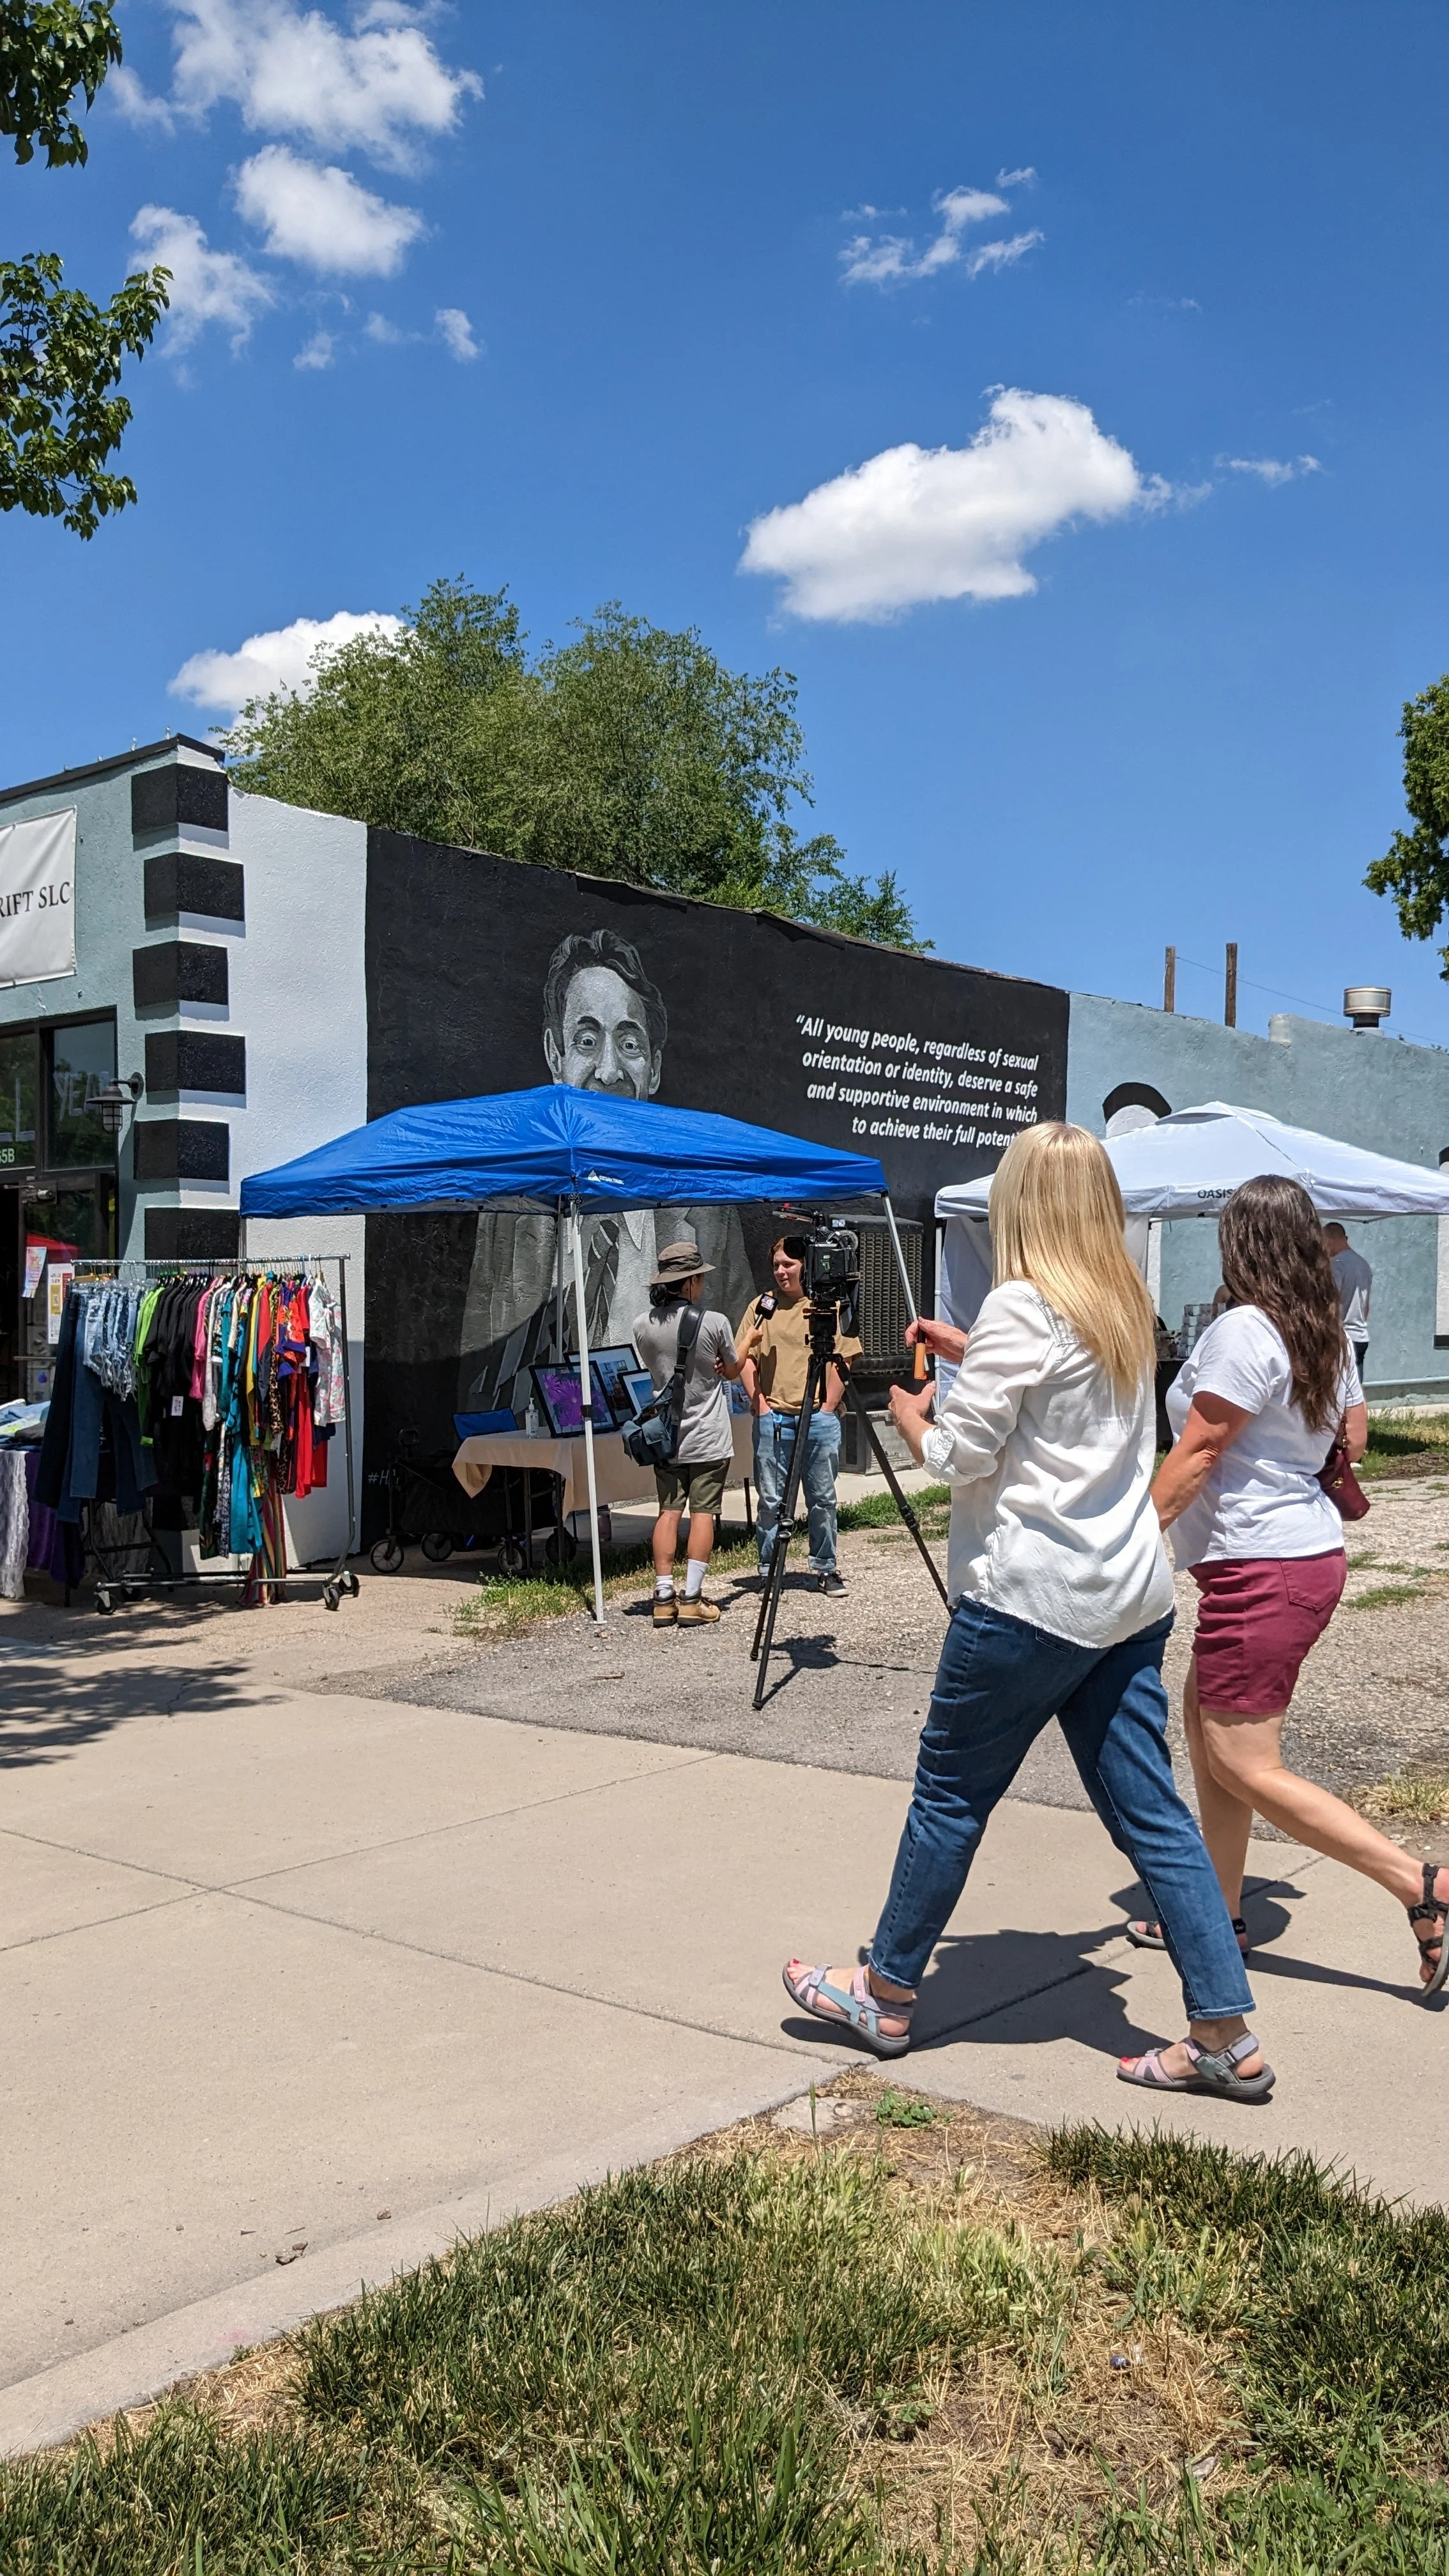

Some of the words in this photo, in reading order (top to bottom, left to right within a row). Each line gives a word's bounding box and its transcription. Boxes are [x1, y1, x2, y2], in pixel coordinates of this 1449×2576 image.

[38, 882, 70, 908] SLC
[824, 1024, 870, 1049] young
[871, 1032, 920, 1055] people,
[923, 1041, 986, 1061] regardless
[988, 1048, 1003, 1068] of
[1002, 1054, 1039, 1071] sexual
[802, 1050, 882, 1076] orientation
[884, 1063, 901, 1078] or
[901, 1061, 954, 1089] identity,
[958, 1070, 1003, 1092] deserve
[1004, 1080, 1013, 1093] a
[1014, 1080, 1039, 1100] safe
[807, 1081, 838, 1100] and
[838, 1087, 910, 1112] supportive
[912, 1094, 990, 1118] environment
[991, 1101, 1003, 1119] in
[1006, 1105, 1038, 1124] which
[852, 1117, 867, 1134] to
[870, 1117, 921, 1139] achieve
[923, 1122, 954, 1142] their
[952, 1124, 977, 1146] full
[976, 1130, 1020, 1148] potent
